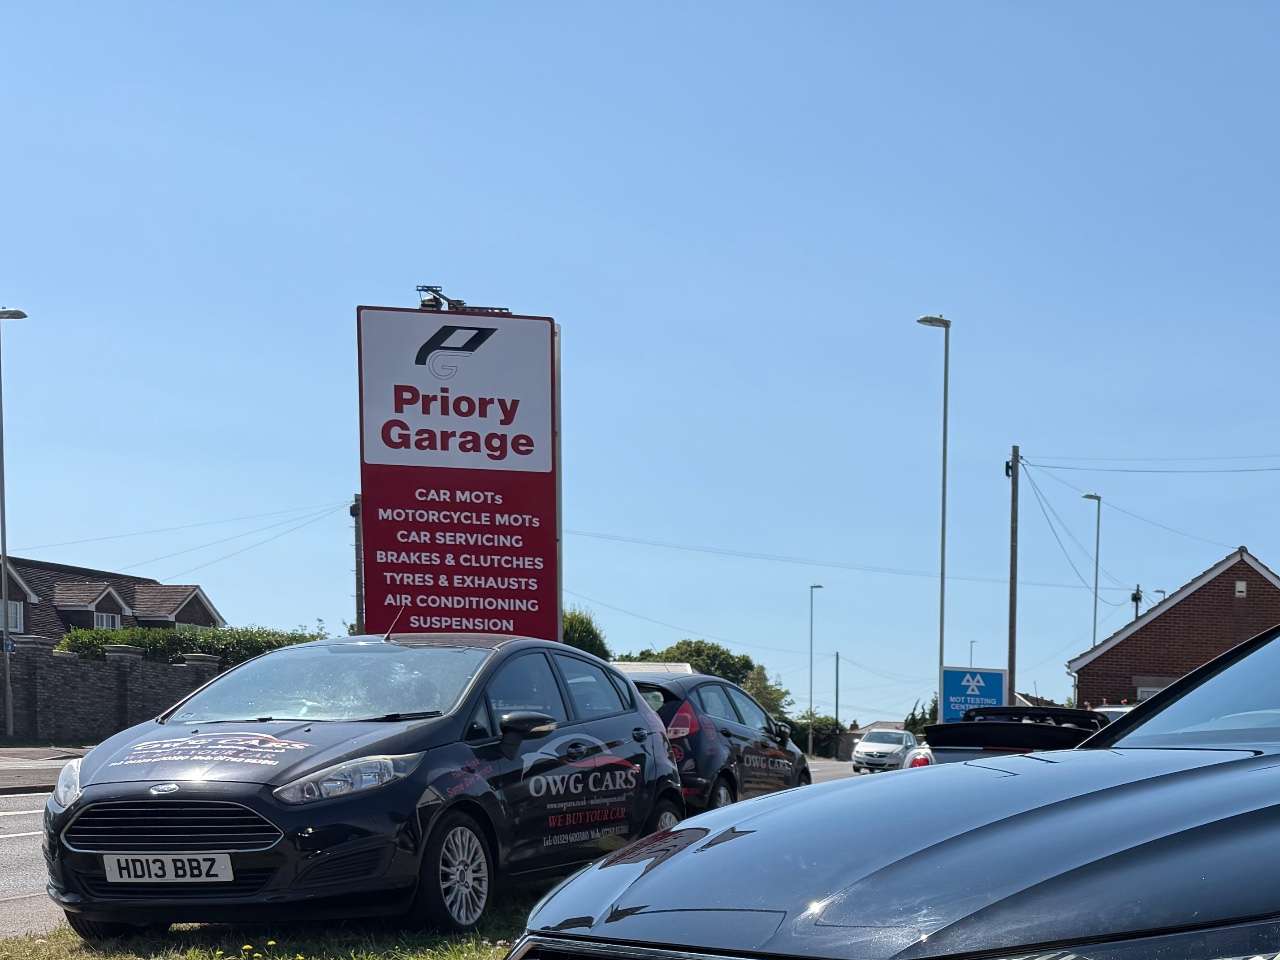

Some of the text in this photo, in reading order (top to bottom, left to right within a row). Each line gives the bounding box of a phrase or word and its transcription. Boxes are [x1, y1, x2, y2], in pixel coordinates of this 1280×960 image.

[393, 384, 520, 425] Priory
[381, 419, 535, 461] Garage
[415, 488, 503, 505] CAR MOTs
[378, 508, 540, 528] MOTORCYCLE MOTs
[396, 530, 523, 548] CAR SERVICING
[376, 551, 544, 570] BRAKES & CLUTCHES
[384, 572, 538, 591] TYRES & EXHAUSTS
[384, 593, 539, 612] AIR CONDITIONING
[409, 615, 514, 632] SUSPENSION
[528, 769, 637, 798] OWG CARS
[565, 811, 586, 825] BUY
[586, 808, 609, 822] YOUR
[116, 857, 219, 879] HD13 BBZ
